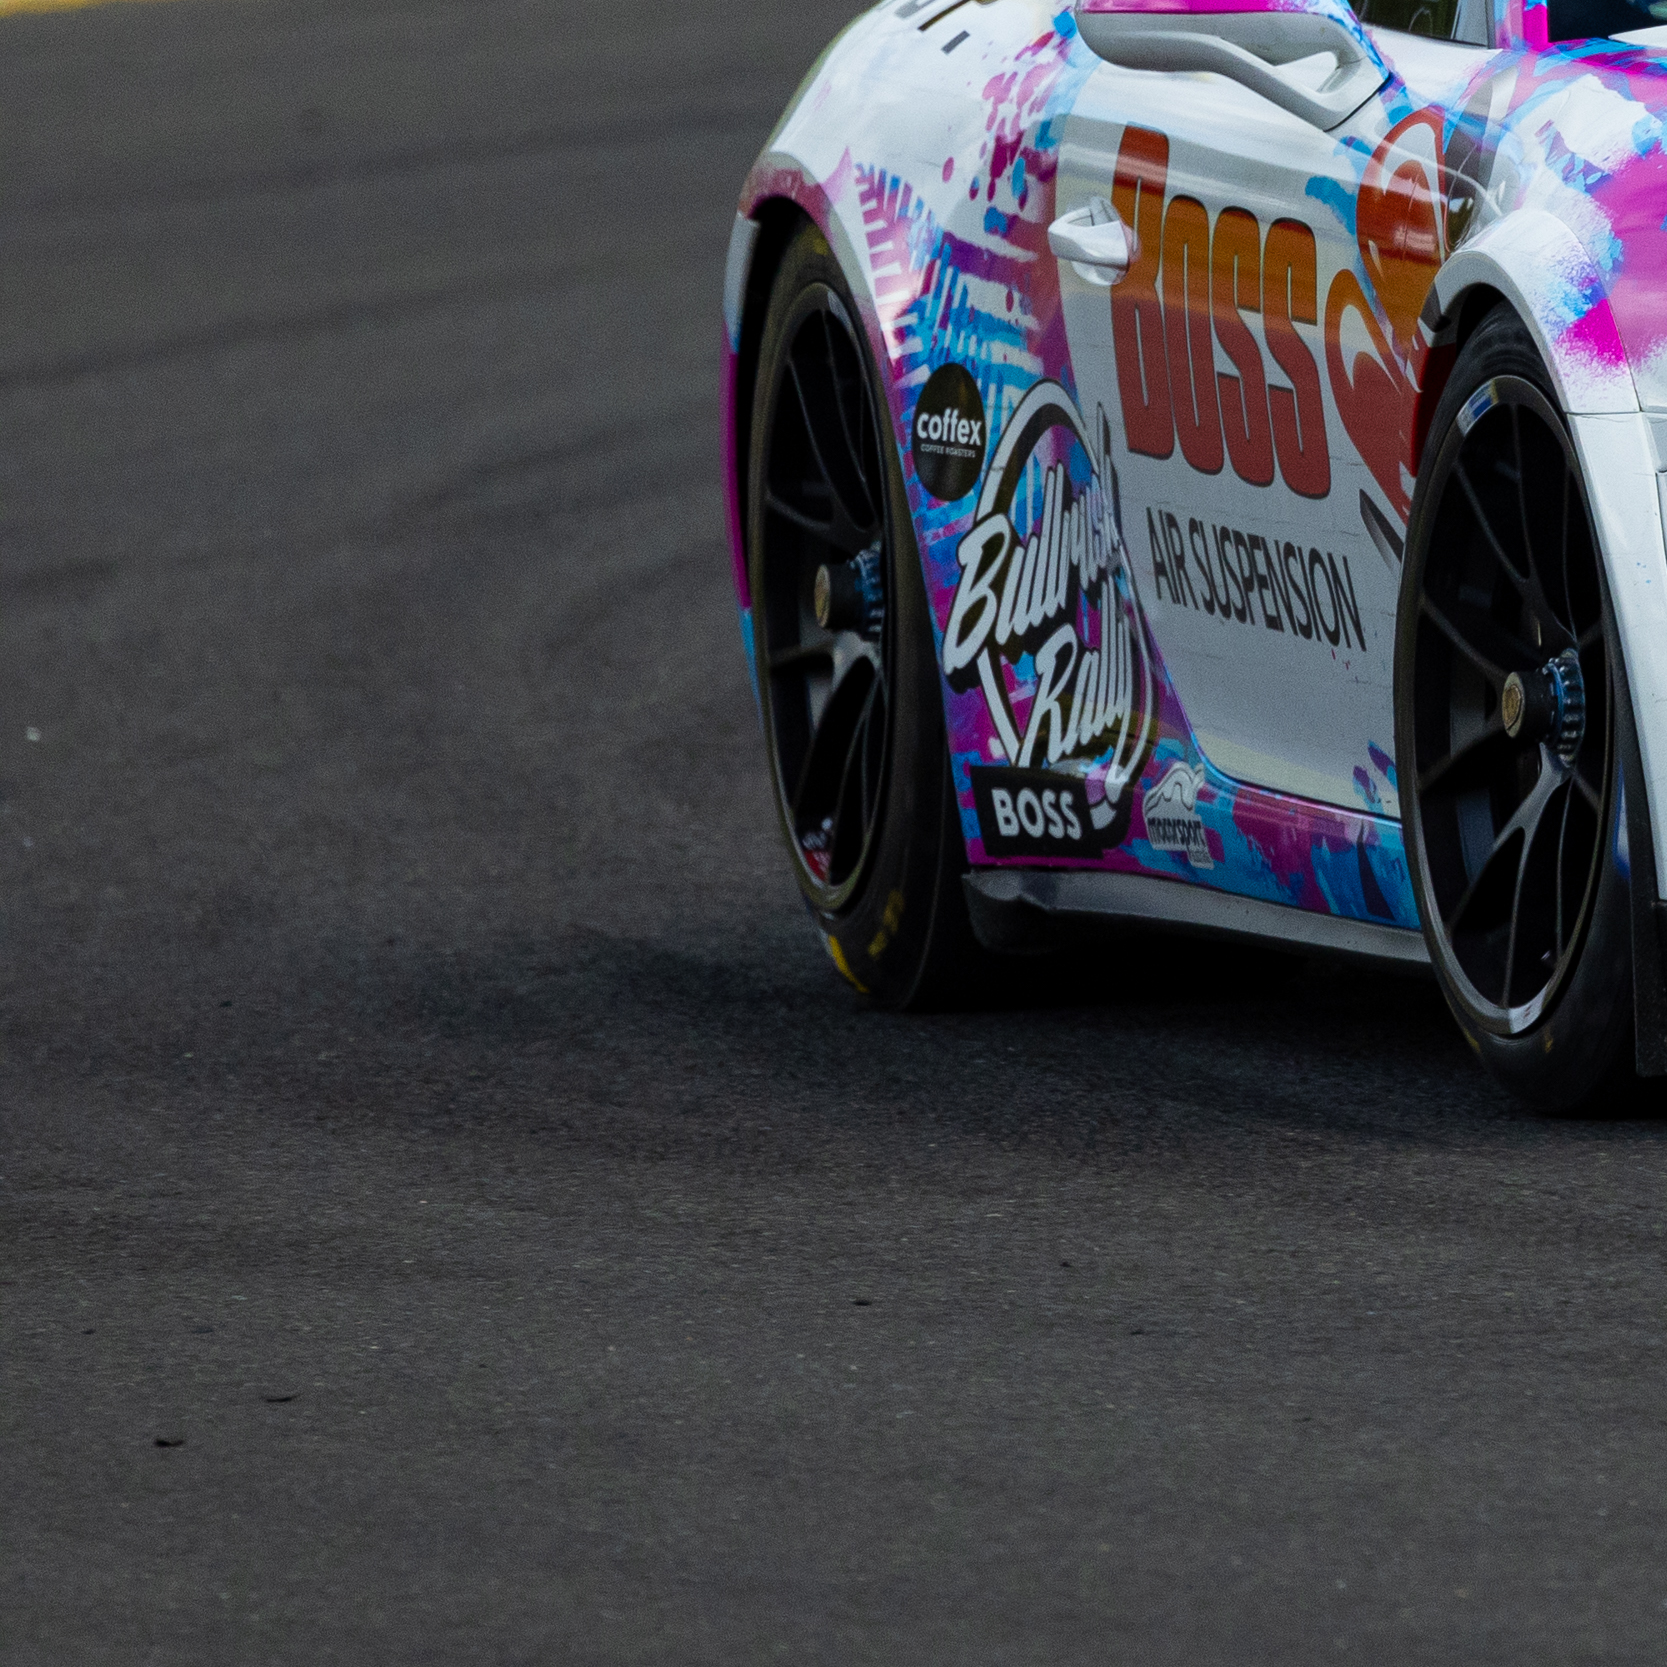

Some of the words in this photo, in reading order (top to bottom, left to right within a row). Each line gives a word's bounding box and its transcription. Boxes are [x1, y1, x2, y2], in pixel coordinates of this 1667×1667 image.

[1110, 120, 1332, 500] BOSS
[917, 407, 981, 446] coffex
[1146, 506, 1200, 611] AIR
[1187, 516, 1367, 652] SUSPENSION
[991, 787, 1083, 840] BOSS
